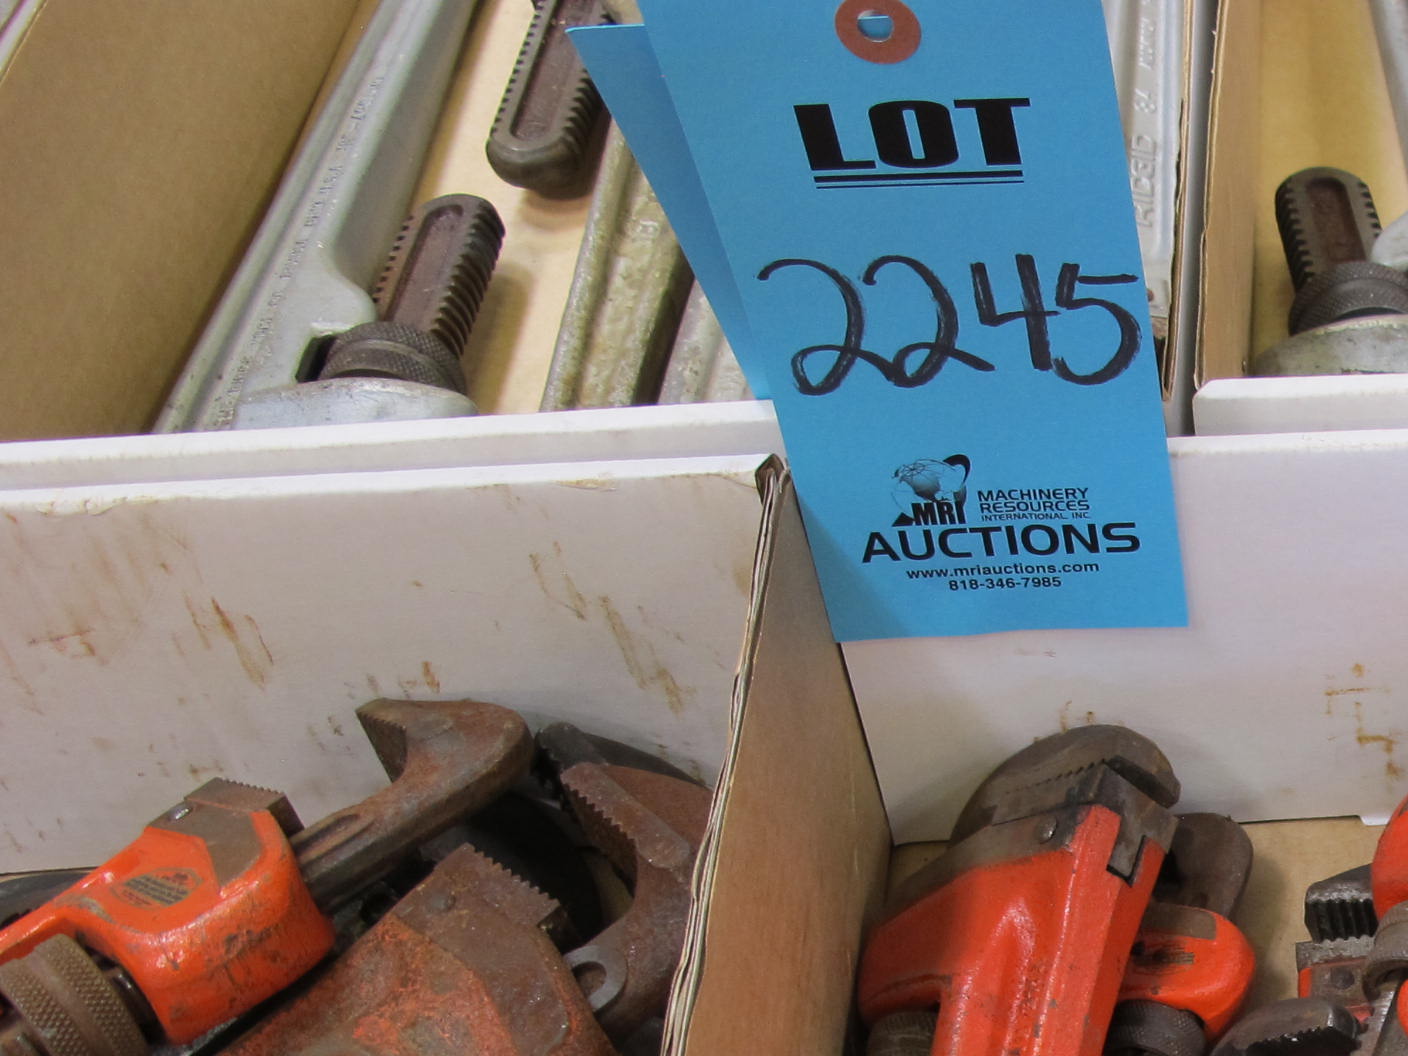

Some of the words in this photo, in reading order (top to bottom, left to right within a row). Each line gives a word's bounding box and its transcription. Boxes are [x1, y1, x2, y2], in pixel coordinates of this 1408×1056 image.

[793, 98, 1031, 171] LOT
[756, 254, 1143, 395] 2245
[978, 488, 1088, 501] MACHINERY
[911, 500, 967, 526] MRI
[980, 500, 1090, 513] RESOURCES
[862, 522, 1141, 563] AUCTIONS
[906, 562, 1100, 579] www.mriauctions.com
[949, 576, 1062, 591] 818-346-7985
